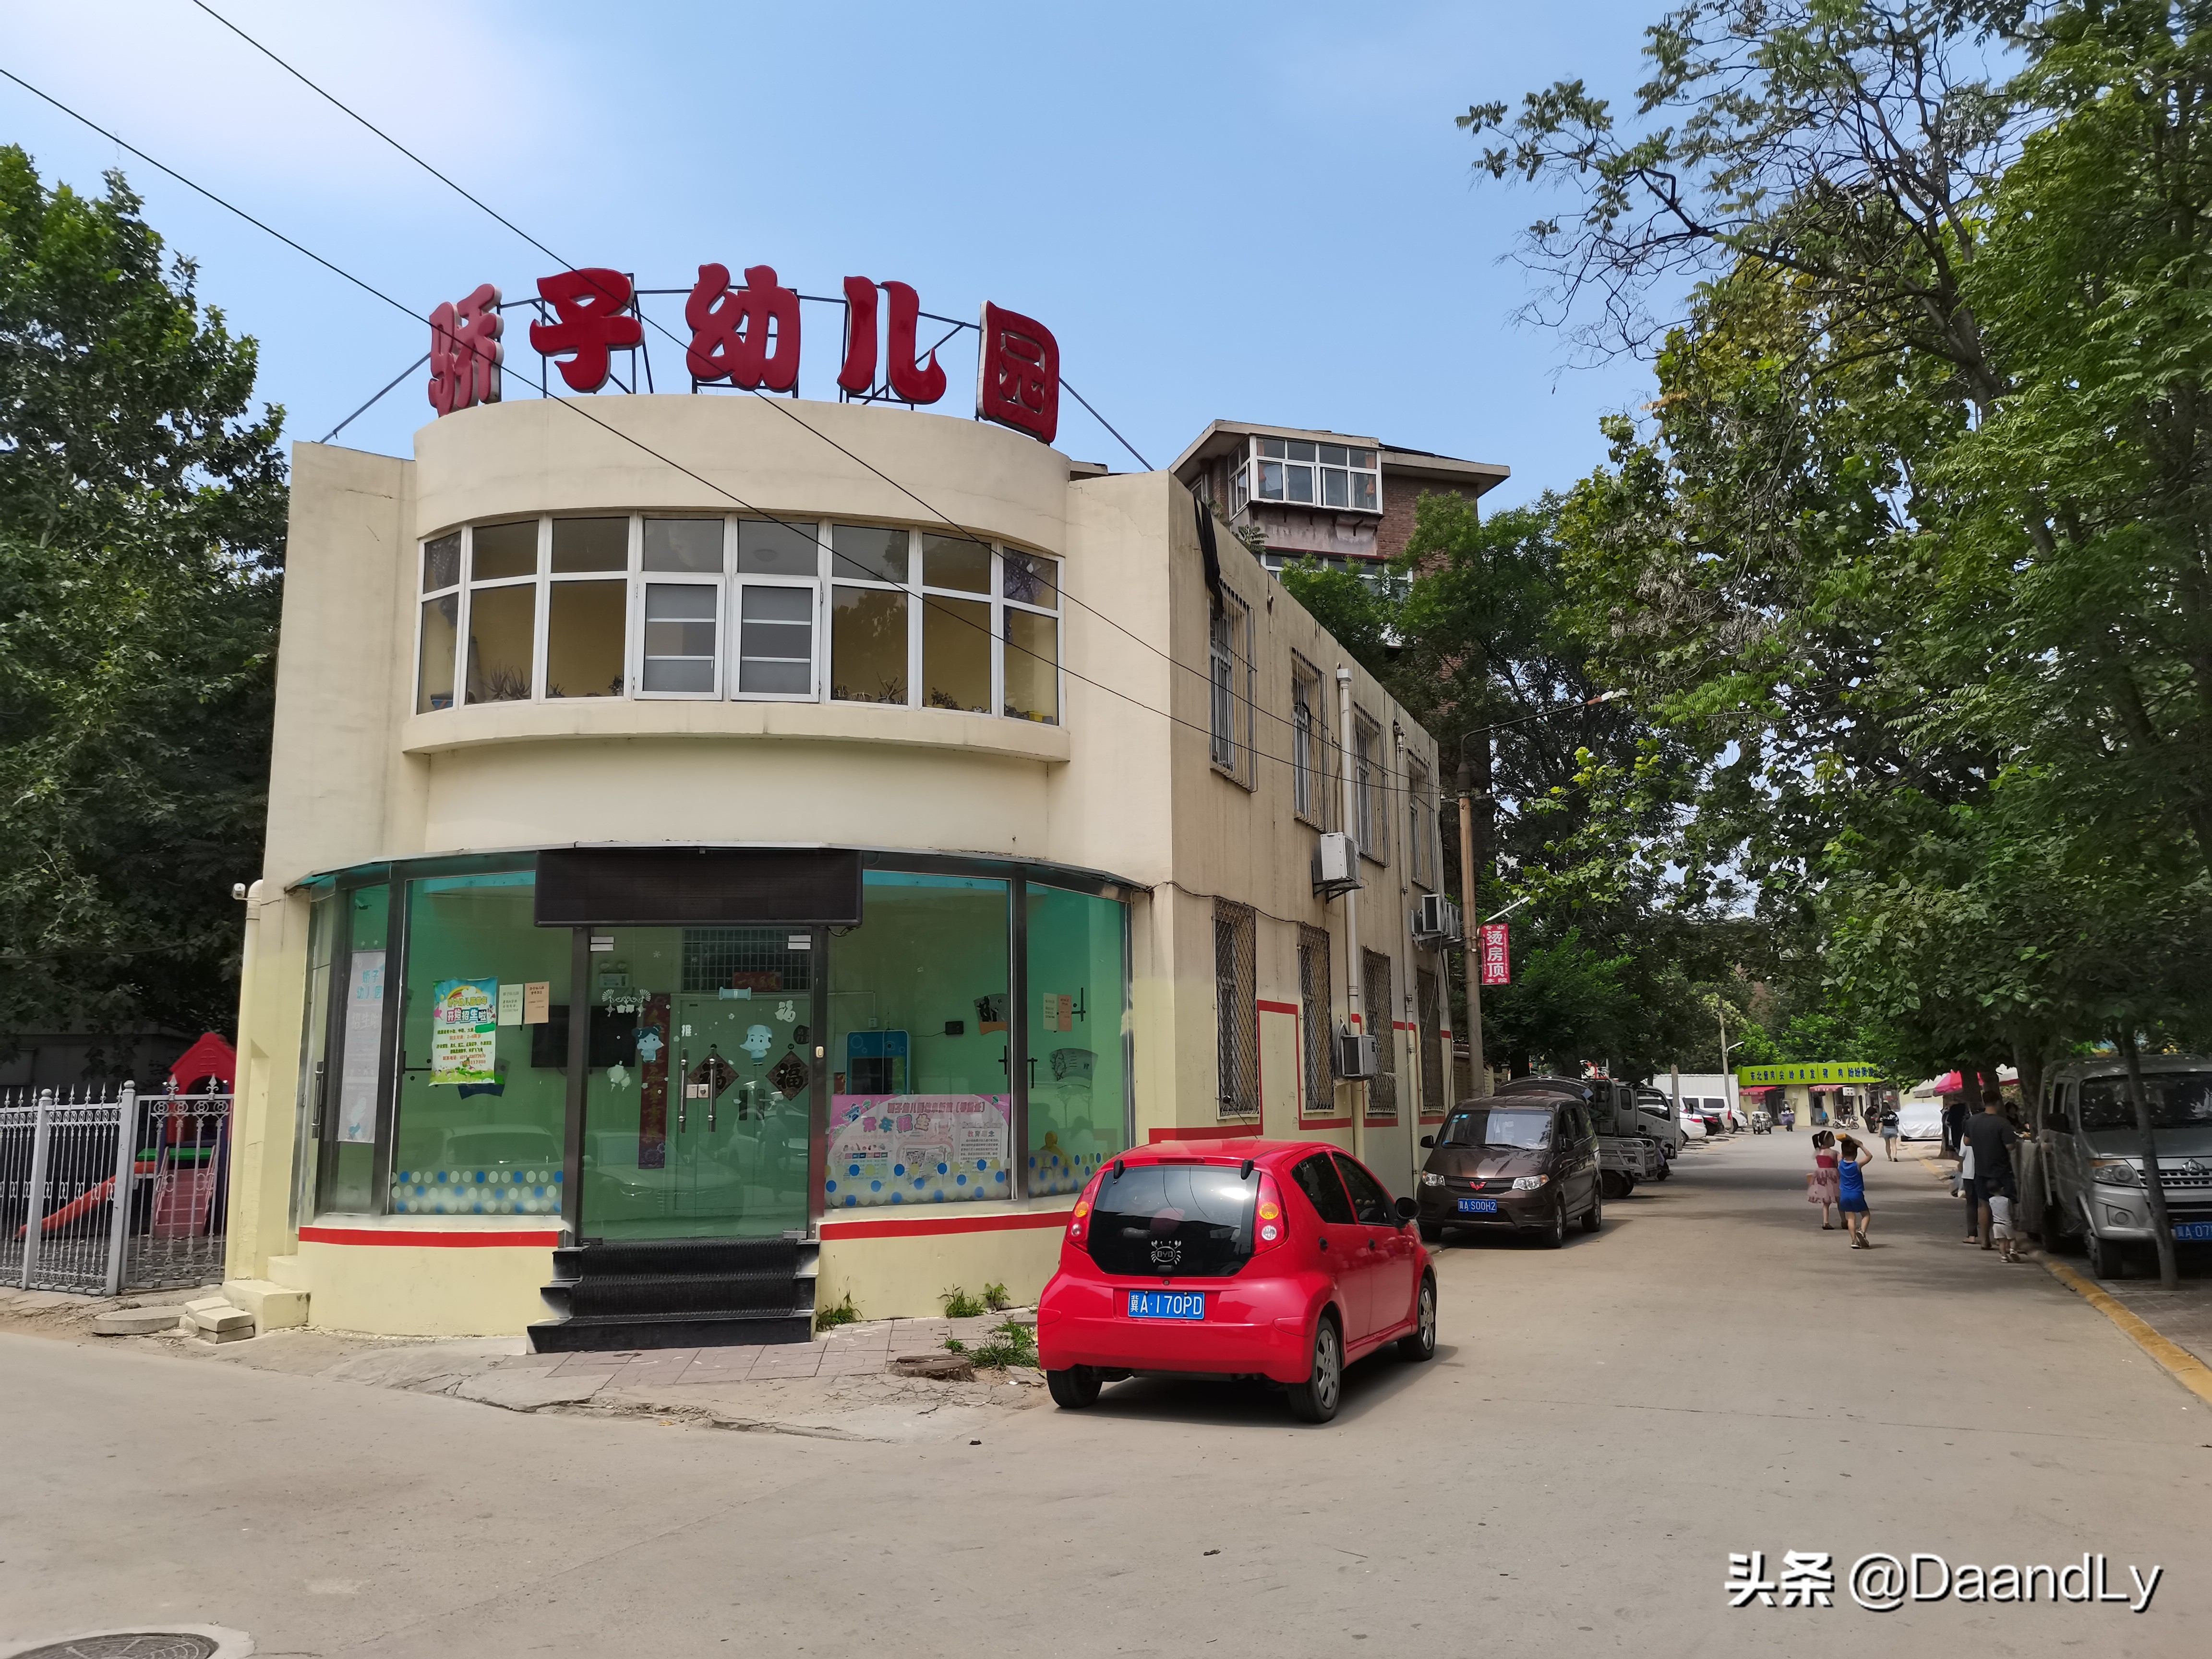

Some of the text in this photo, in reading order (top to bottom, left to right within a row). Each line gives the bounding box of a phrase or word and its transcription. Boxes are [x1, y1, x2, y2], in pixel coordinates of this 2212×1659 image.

[1487, 930, 1505, 977] 烫房顶
[446, 1008, 487, 1022] 开始招生啦
[682, 1024, 692, 1036] 推
[776, 1062, 804, 1089] 福
